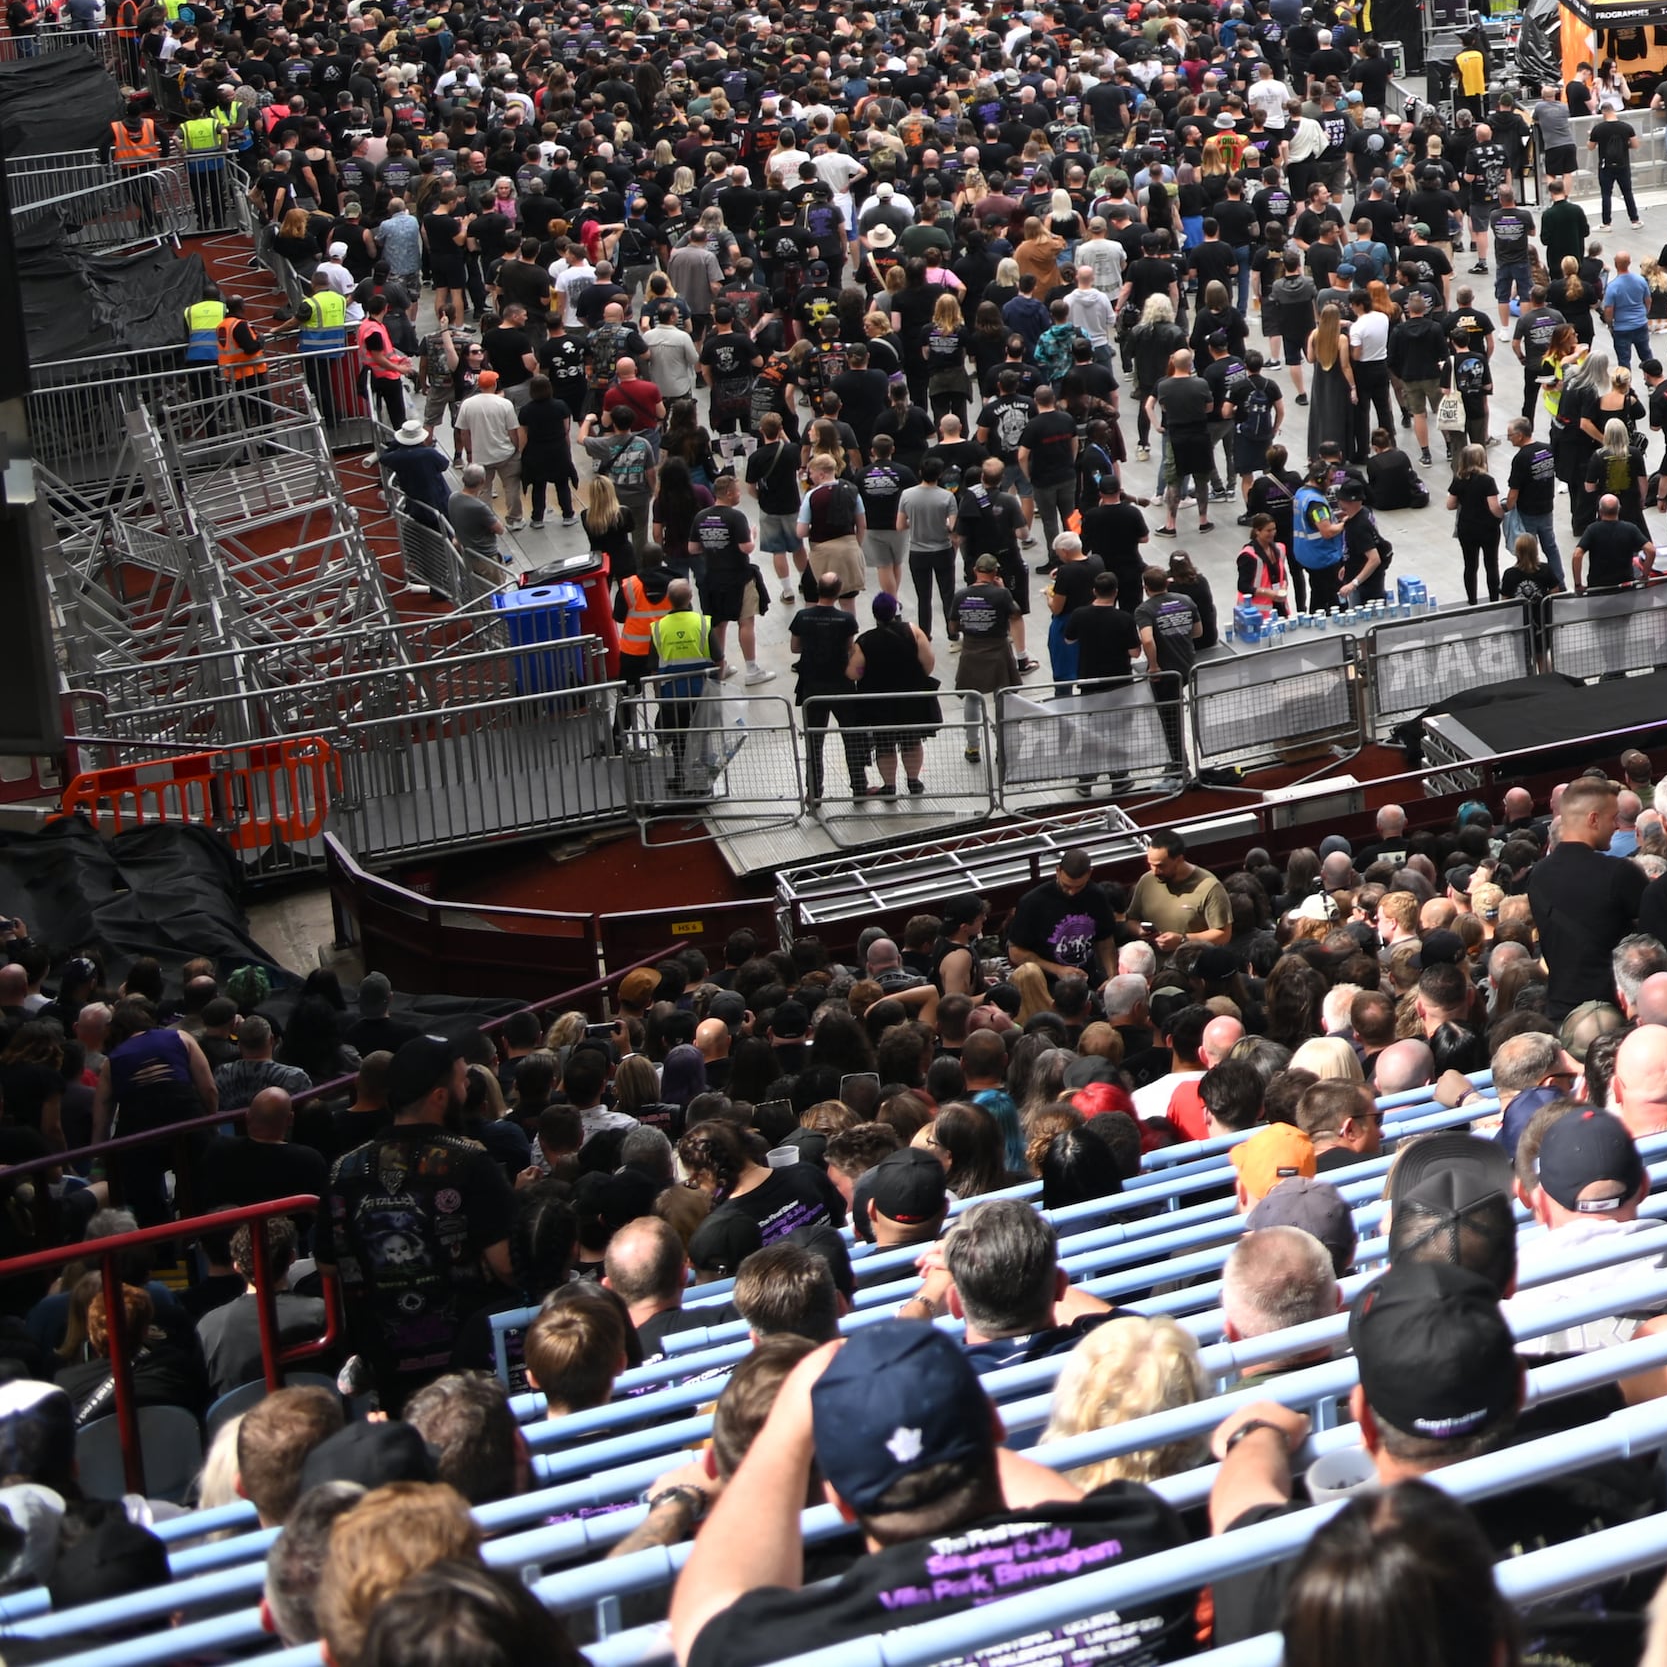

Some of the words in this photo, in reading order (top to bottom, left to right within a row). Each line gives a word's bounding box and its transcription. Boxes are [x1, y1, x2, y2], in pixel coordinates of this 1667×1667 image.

[1595, 8, 1650, 20] PROGRAMMES
[926, 1545, 1014, 1576] Saturday
[1014, 1542, 1031, 1558] 5
[1032, 1527, 1073, 1554] July
[930, 1535, 967, 1556] The
[965, 1526, 1010, 1549] Final
[933, 1572, 995, 1601] Park,
[994, 1539, 1123, 1588] Birmingham
